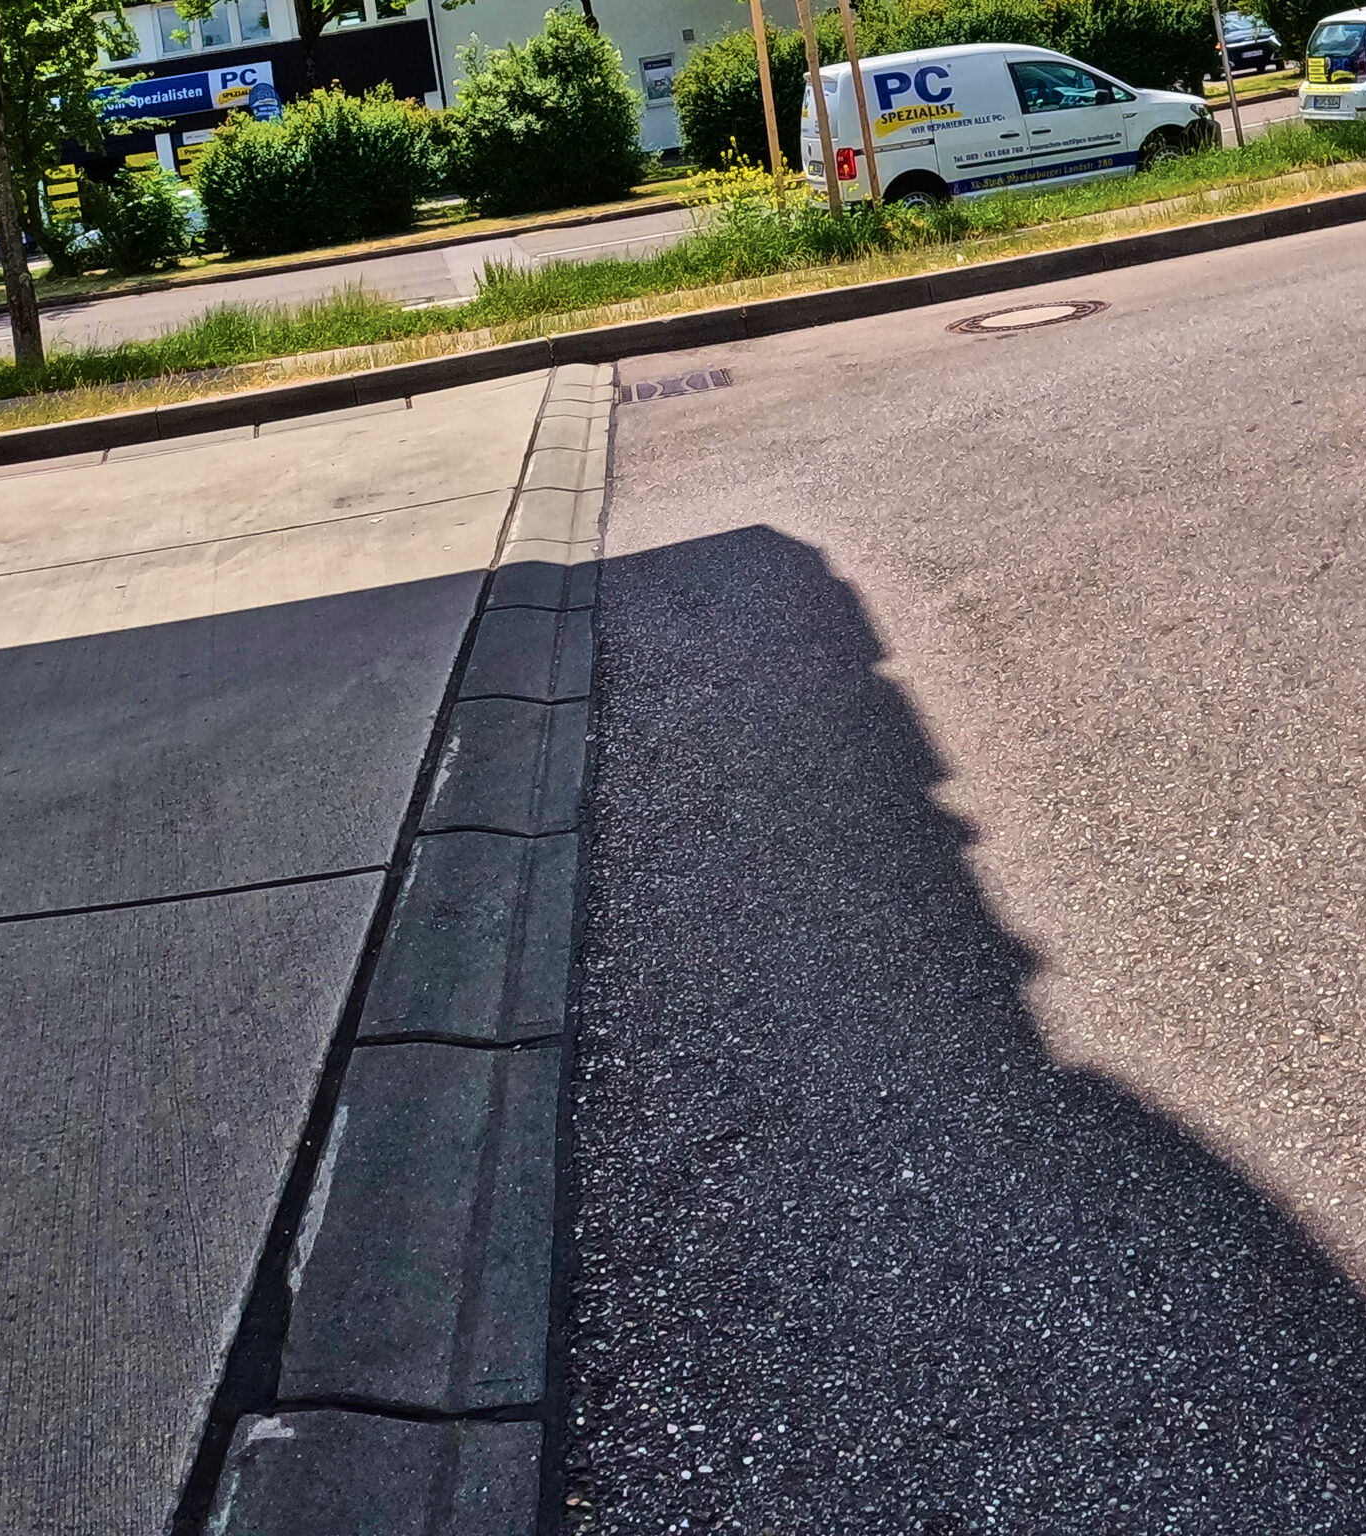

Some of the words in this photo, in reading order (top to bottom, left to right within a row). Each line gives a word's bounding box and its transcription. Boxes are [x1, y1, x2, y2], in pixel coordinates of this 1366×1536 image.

[220, 68, 258, 90] PC
[873, 65, 953, 111] PC
[129, 86, 203, 109] Spezialisten
[880, 102, 956, 125] SPEZIALIST
[910, 125, 926, 135] WIR
[927, 118, 973, 132] REPARIEREN
[974, 115, 991, 125] ALLE
